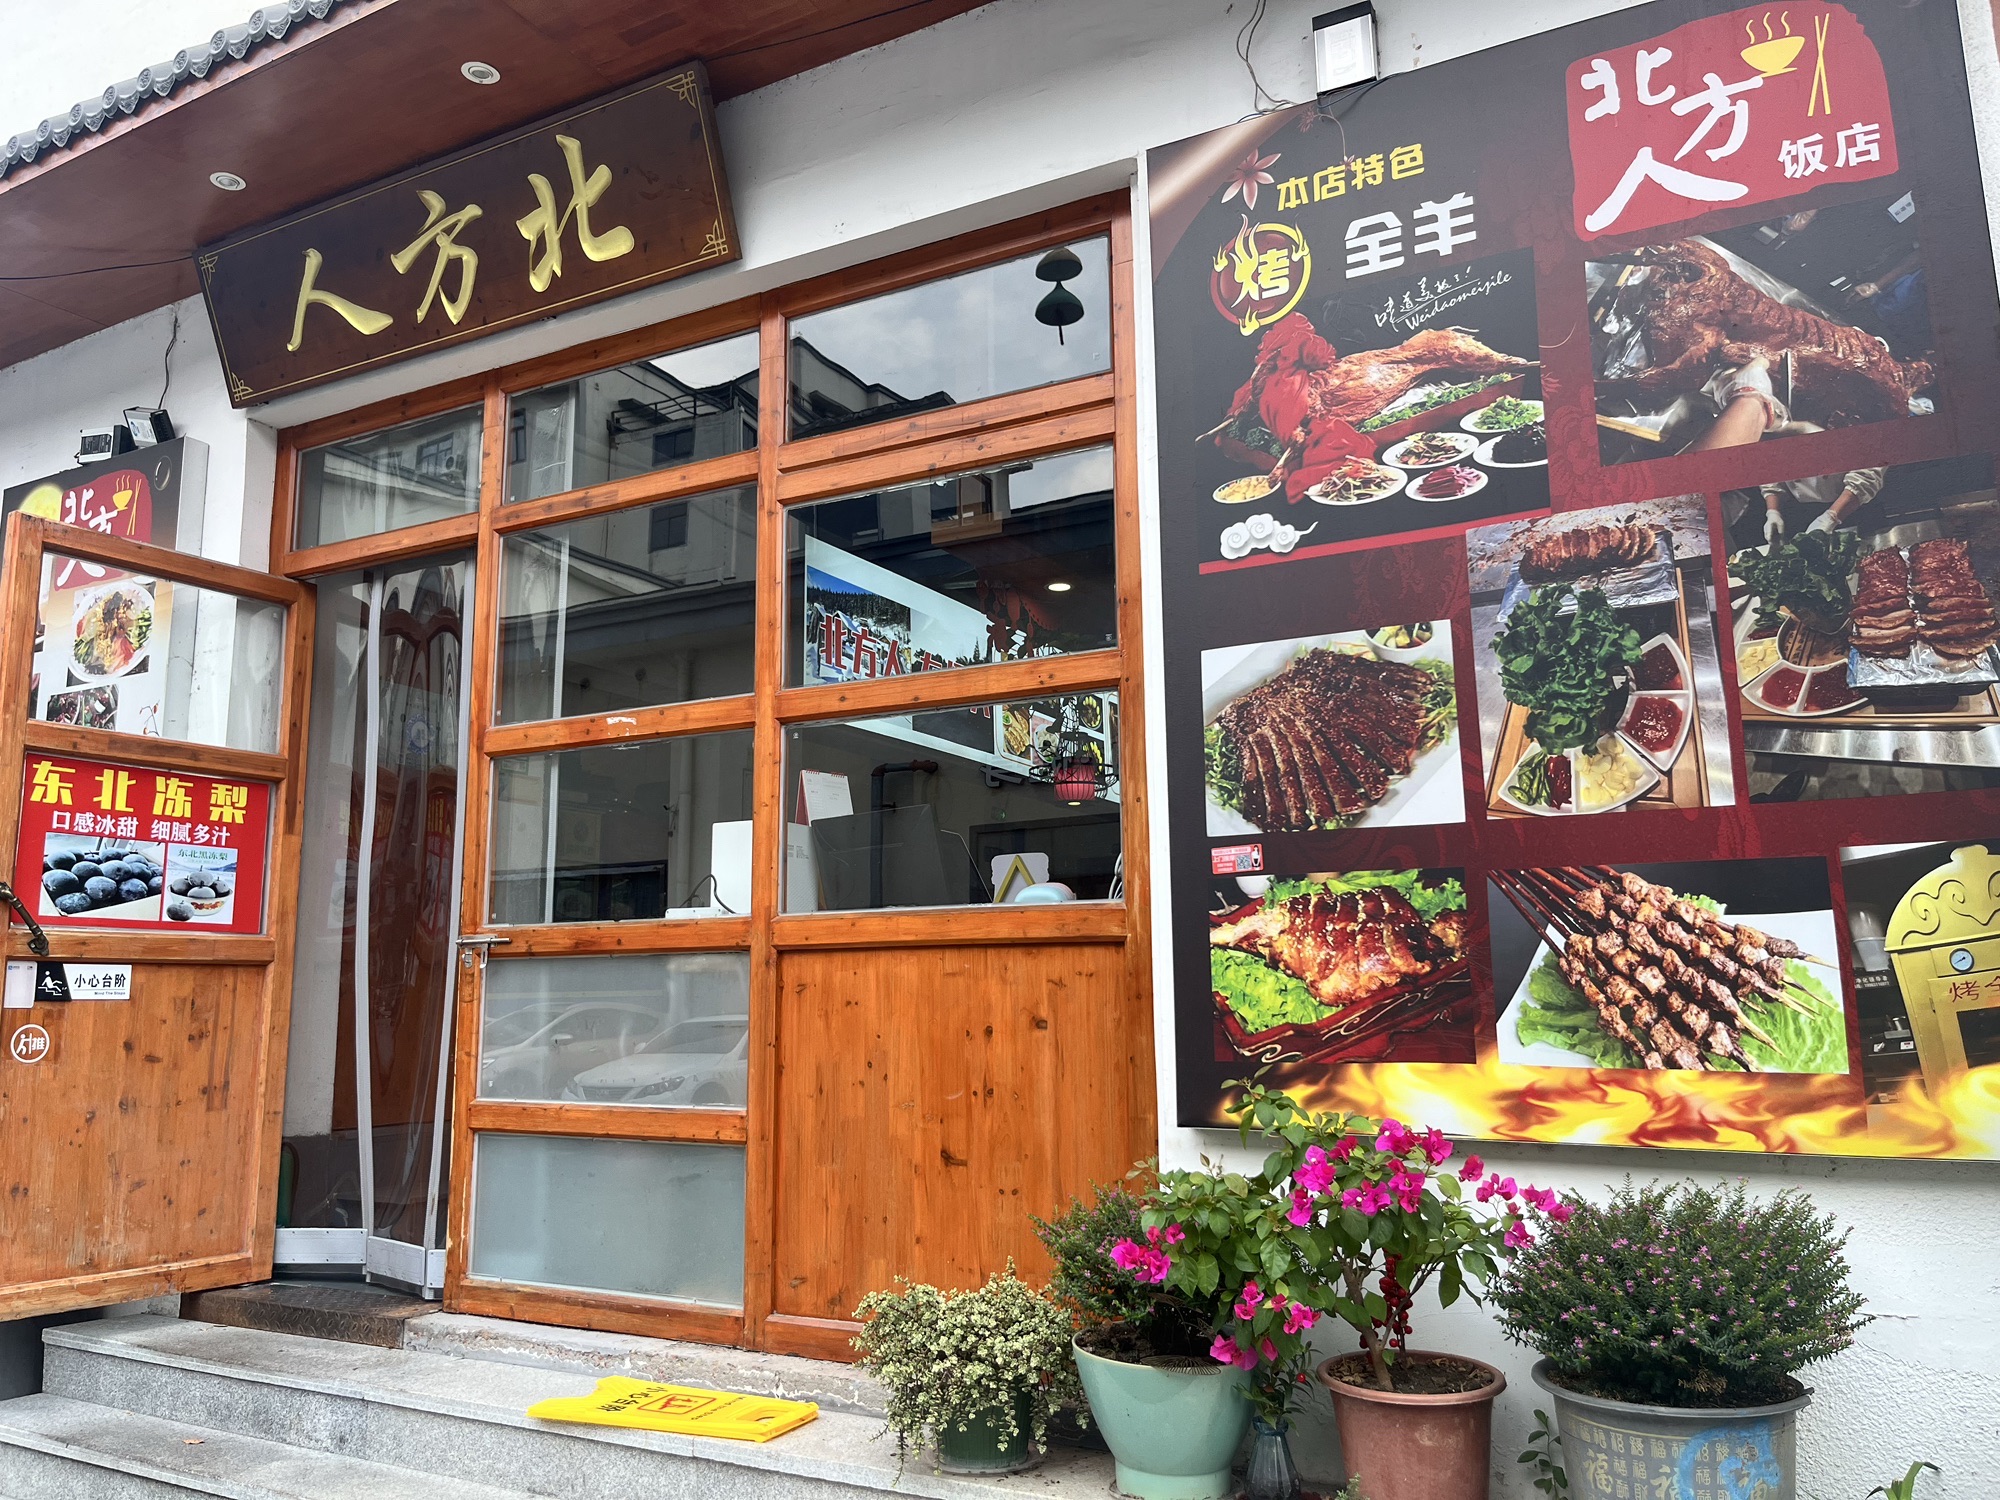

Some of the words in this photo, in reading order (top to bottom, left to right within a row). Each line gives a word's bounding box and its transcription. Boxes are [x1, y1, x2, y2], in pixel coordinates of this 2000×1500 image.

[1276, 143, 1426, 212] 本店特色
[1777, 121, 1881, 180] 饭店
[1230, 213, 1290, 309] 烤
[1343, 191, 1478, 280] 全羊
[29, 760, 249, 825] 东北冻梨
[51, 810, 139, 838] 口感冰甜
[150, 819, 231, 847] 细腻多汁
[74, 973, 126, 988] 小心台阶
[31, 1036, 46, 1051] 推
